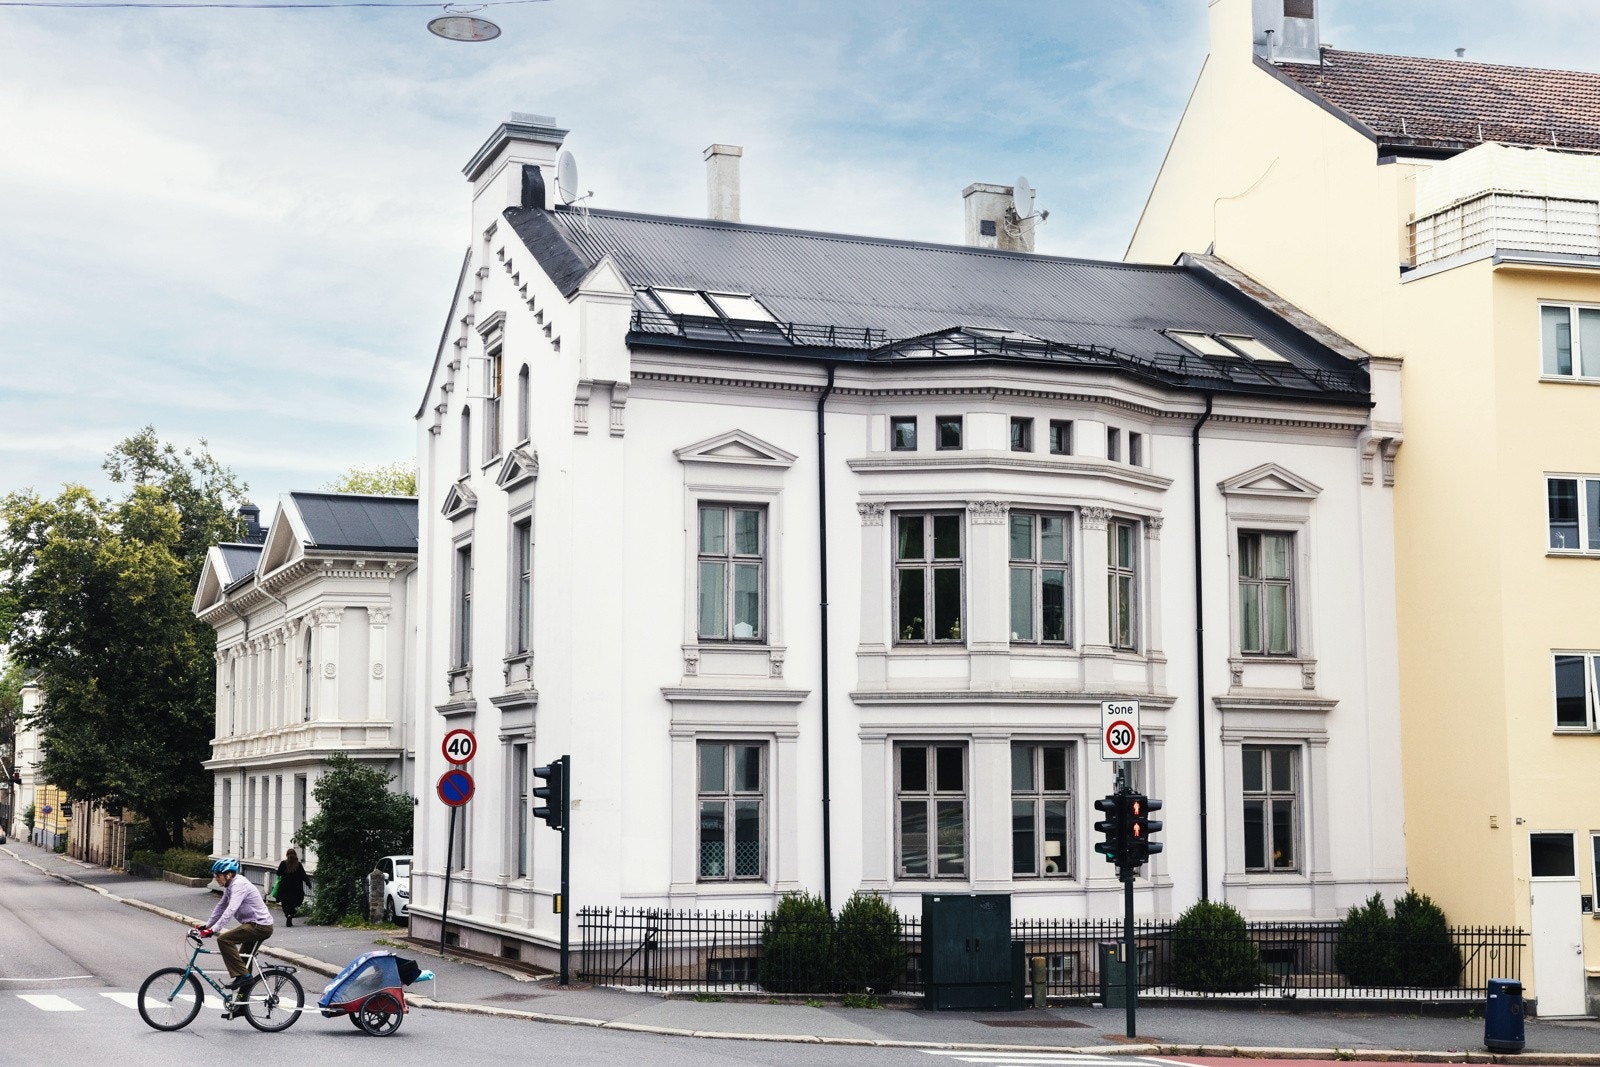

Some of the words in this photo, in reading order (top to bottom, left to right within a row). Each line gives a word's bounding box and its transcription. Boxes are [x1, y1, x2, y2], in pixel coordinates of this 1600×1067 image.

[1108, 704, 1133, 715] Sone
[1112, 729, 1130, 746] 30
[448, 738, 471, 755] 40
